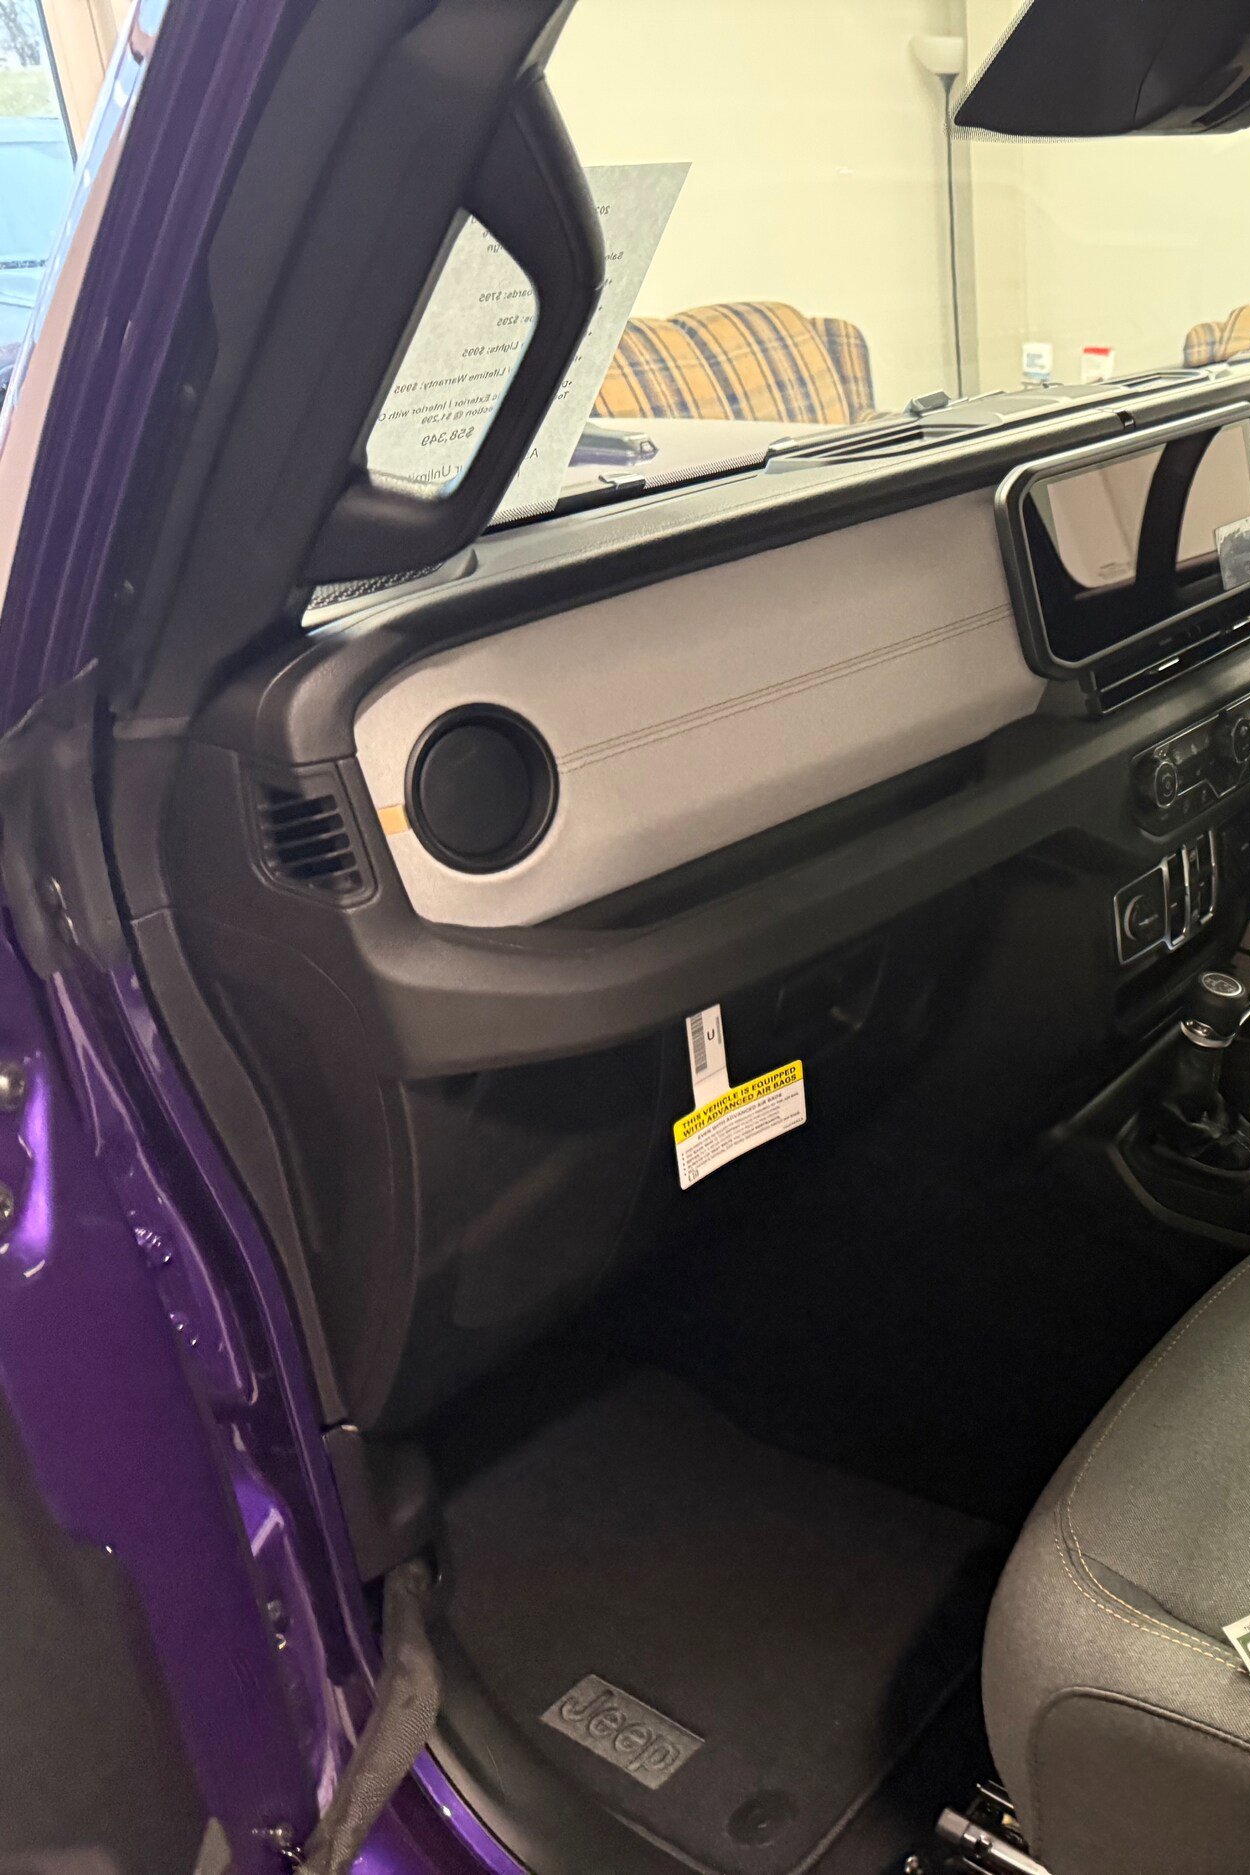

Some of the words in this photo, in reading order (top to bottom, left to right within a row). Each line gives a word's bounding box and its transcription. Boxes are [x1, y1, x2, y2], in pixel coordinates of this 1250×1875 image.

[683, 1112, 702, 1129] THIS
[703, 1090, 739, 1115] VEHICLE
[741, 1085, 750, 1096] IS
[752, 1066, 796, 1092] EQUIPPED
[683, 1121, 705, 1137] WITH
[707, 1094, 754, 1124] ADVANCED
[757, 1085, 772, 1101] AIR
[774, 1074, 797, 1092] BAGS
[558, 1688, 681, 1772] Jeep
